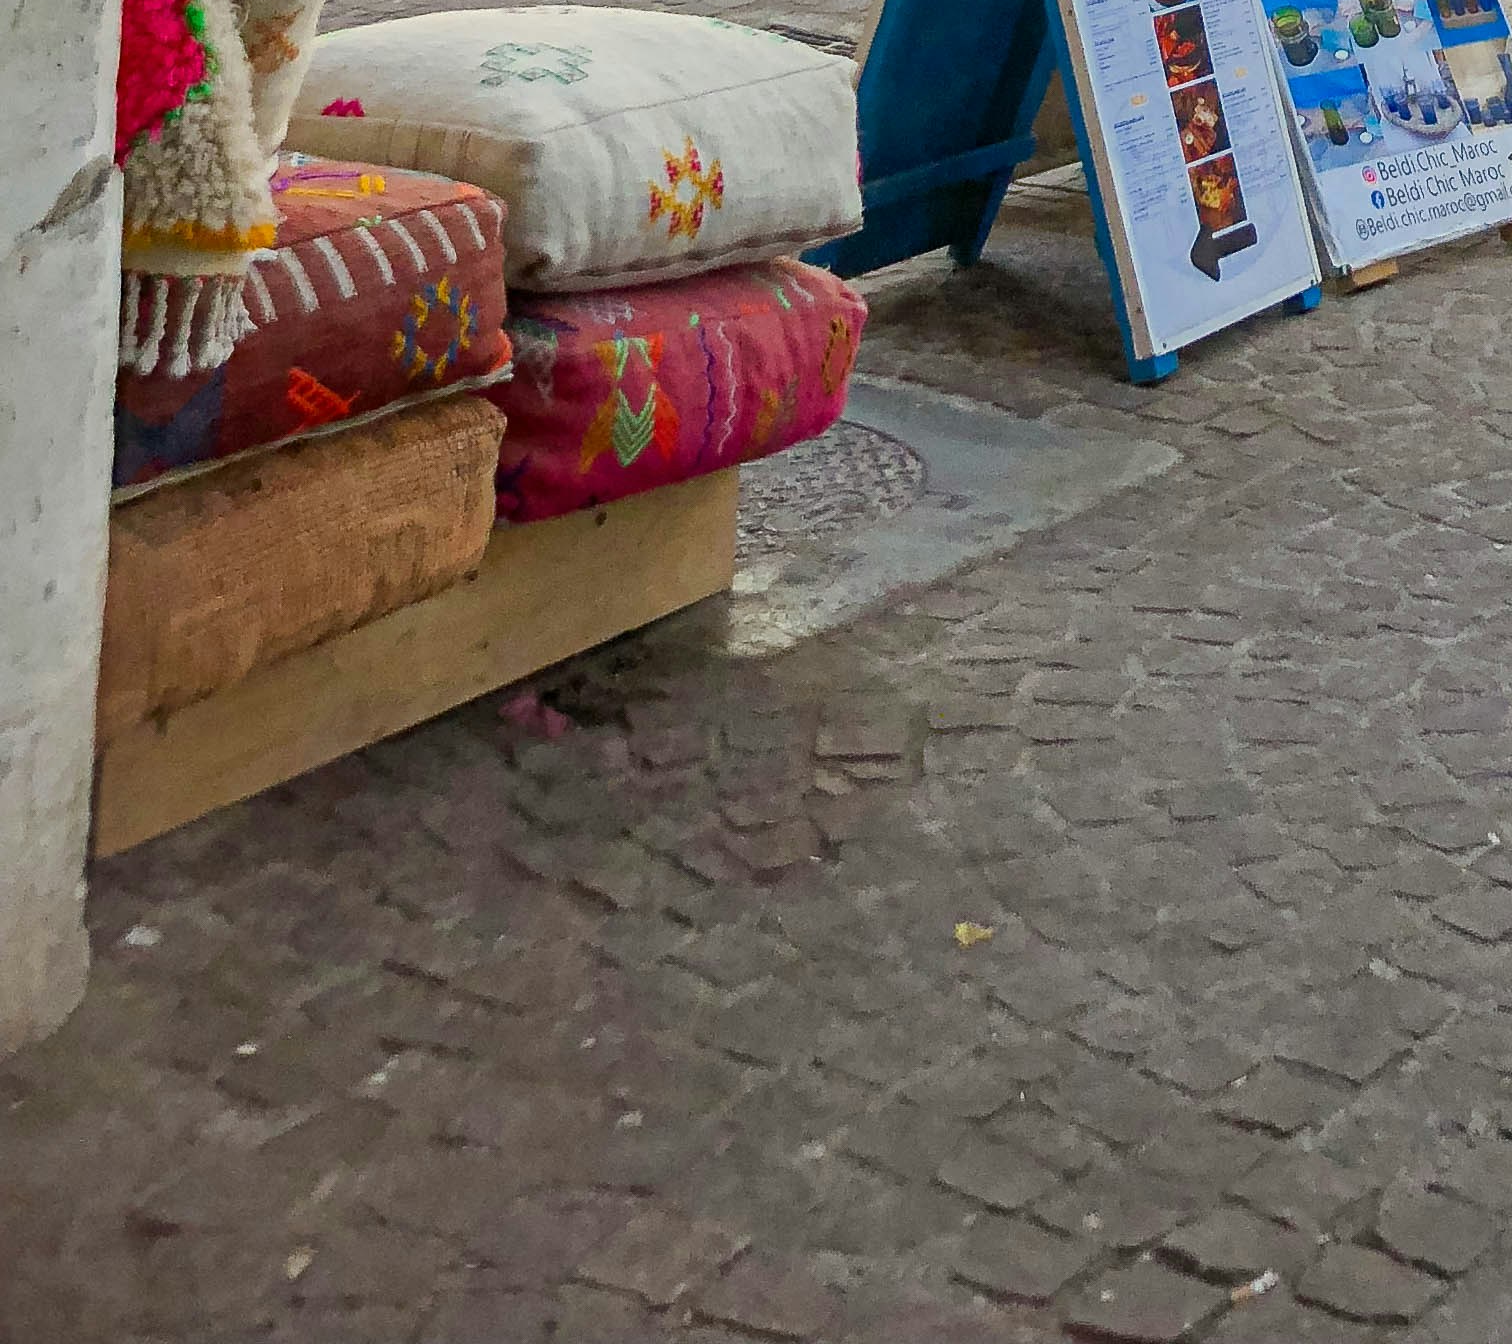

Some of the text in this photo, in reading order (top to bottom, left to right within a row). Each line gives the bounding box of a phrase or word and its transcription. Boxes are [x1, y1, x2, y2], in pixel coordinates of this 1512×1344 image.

[1377, 138, 1498, 182] Beldi.Chic_Maroc
[1386, 163, 1506, 207] Beldi Chic Maroc
